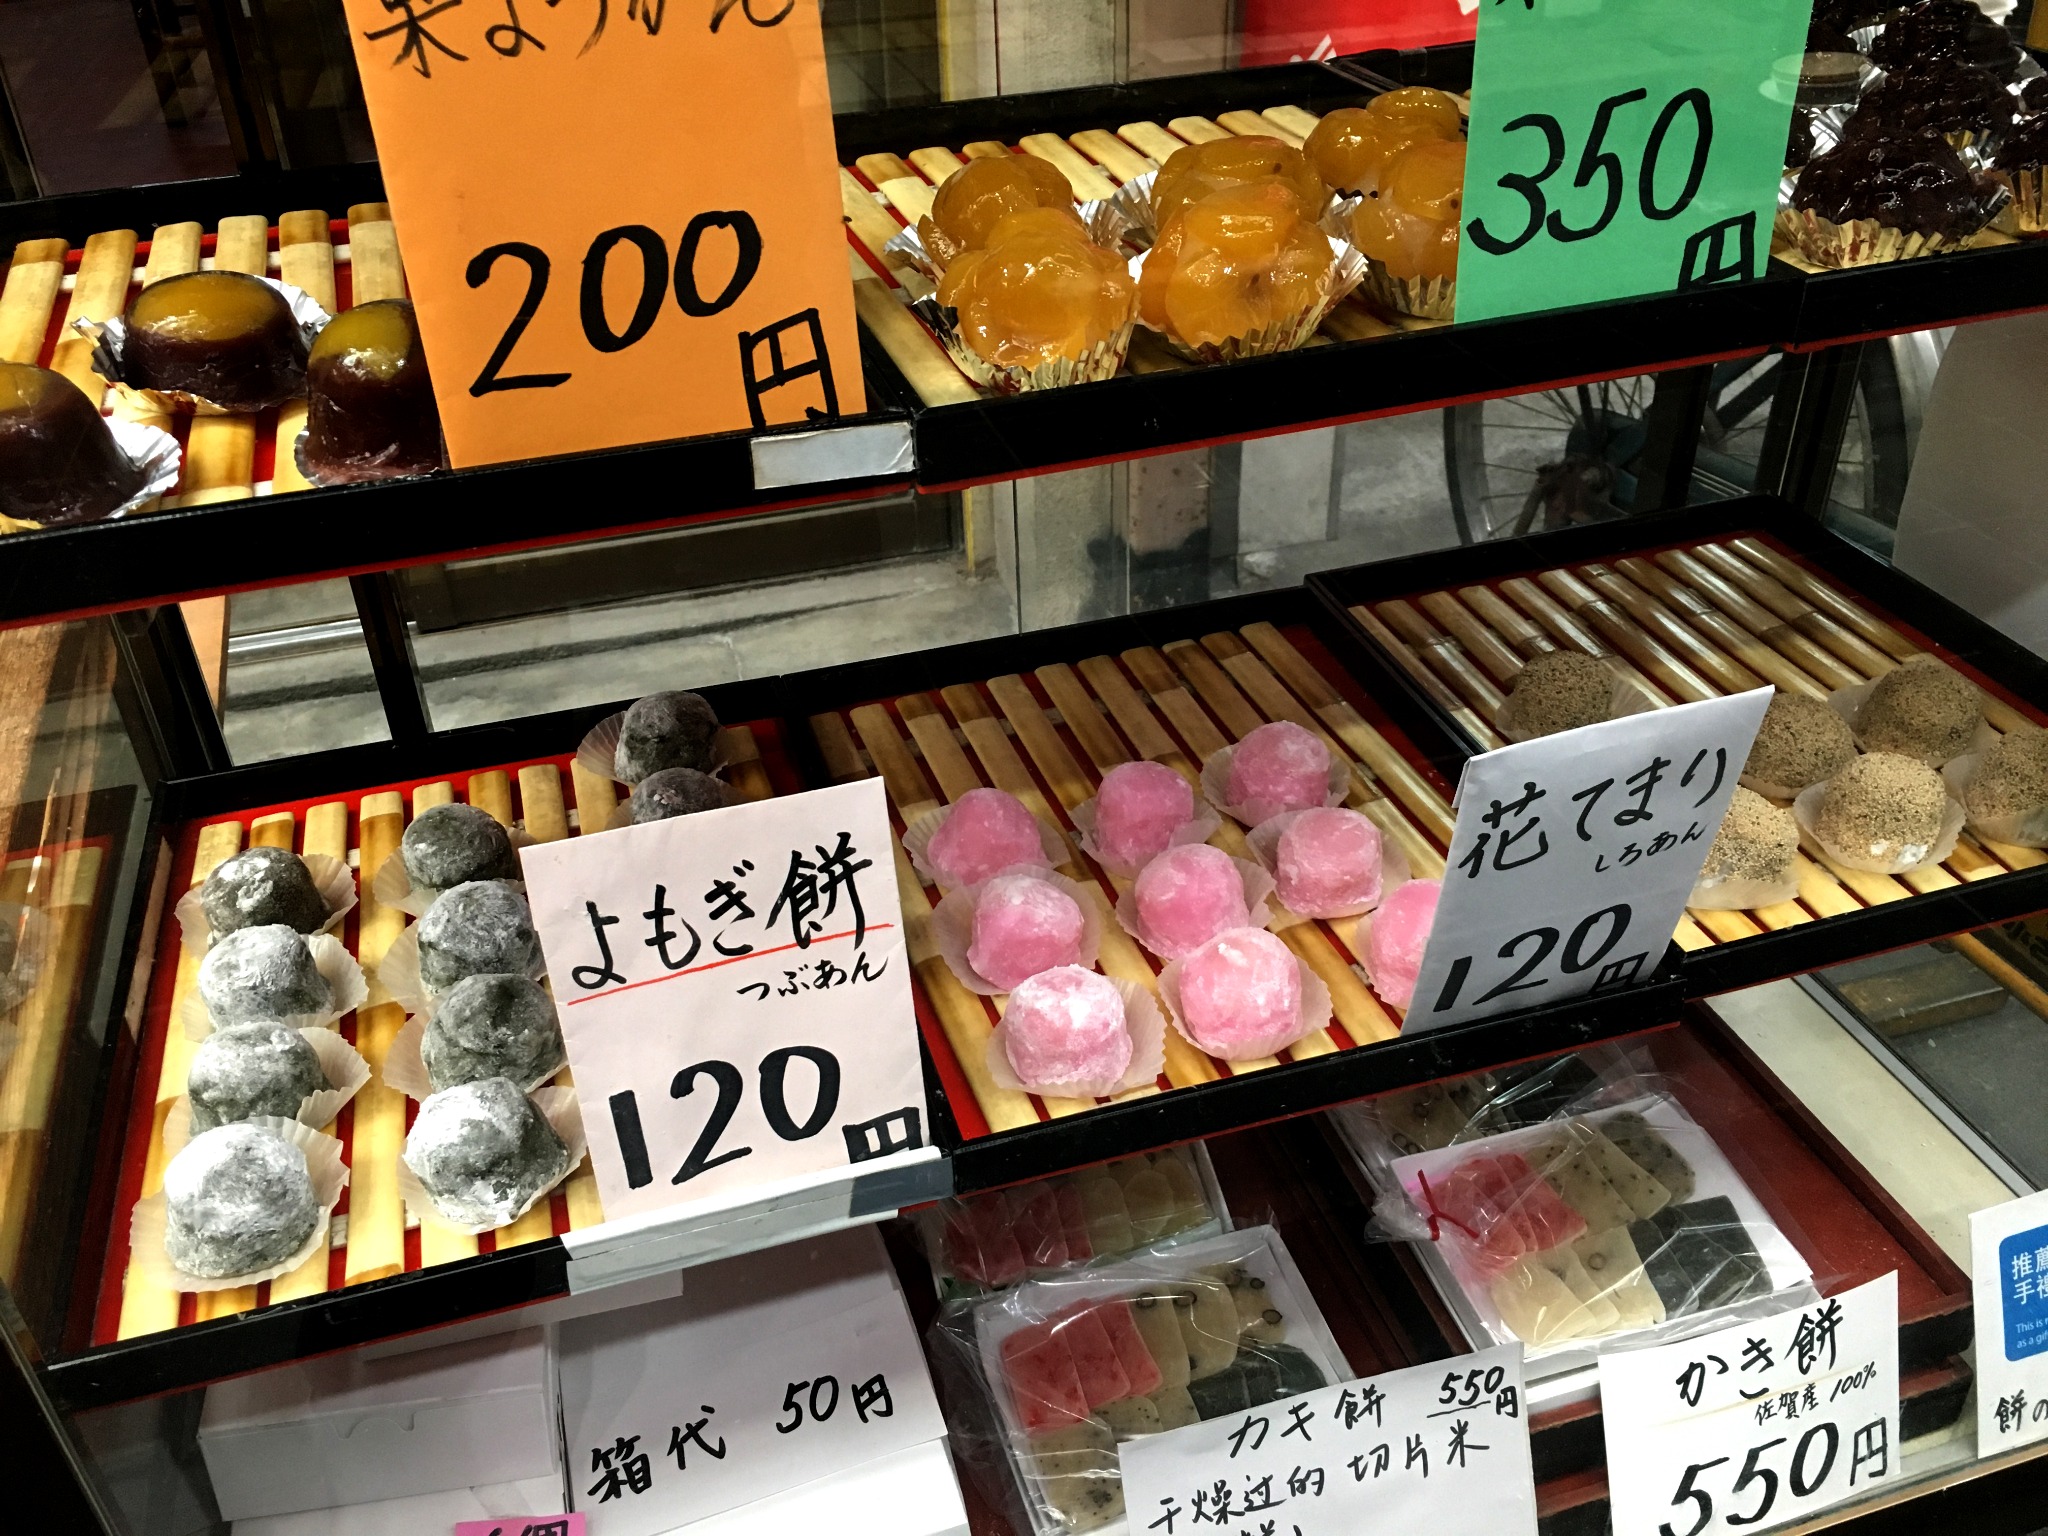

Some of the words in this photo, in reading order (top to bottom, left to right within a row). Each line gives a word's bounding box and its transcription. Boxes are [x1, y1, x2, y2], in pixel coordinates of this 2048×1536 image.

[1466, 88, 1756, 292] 350円
[466, 210, 840, 430] 200円
[1458, 747, 1727, 879] 花てまり
[1594, 821, 1708, 873] しろあん
[572, 832, 872, 990] よもぎ餅
[1433, 903, 1650, 1012] 120円
[737, 951, 888, 1001] つぶあん
[609, 1045, 923, 1189] 120円
[1676, 1298, 1843, 1407] かき餅
[2015, 1321, 2034, 1333] This
[2036, 1317, 2043, 1328] is
[2017, 1339, 2027, 1348] as
[587, 1405, 727, 1504] 箱代
[776, 1374, 894, 1434] 50円
[1437, 1366, 1519, 1418] 550円
[1754, 1382, 1819, 1426] 佐賀産
[1829, 1360, 1876, 1403] 100%
[1658, 1417, 1889, 1536] 550円
